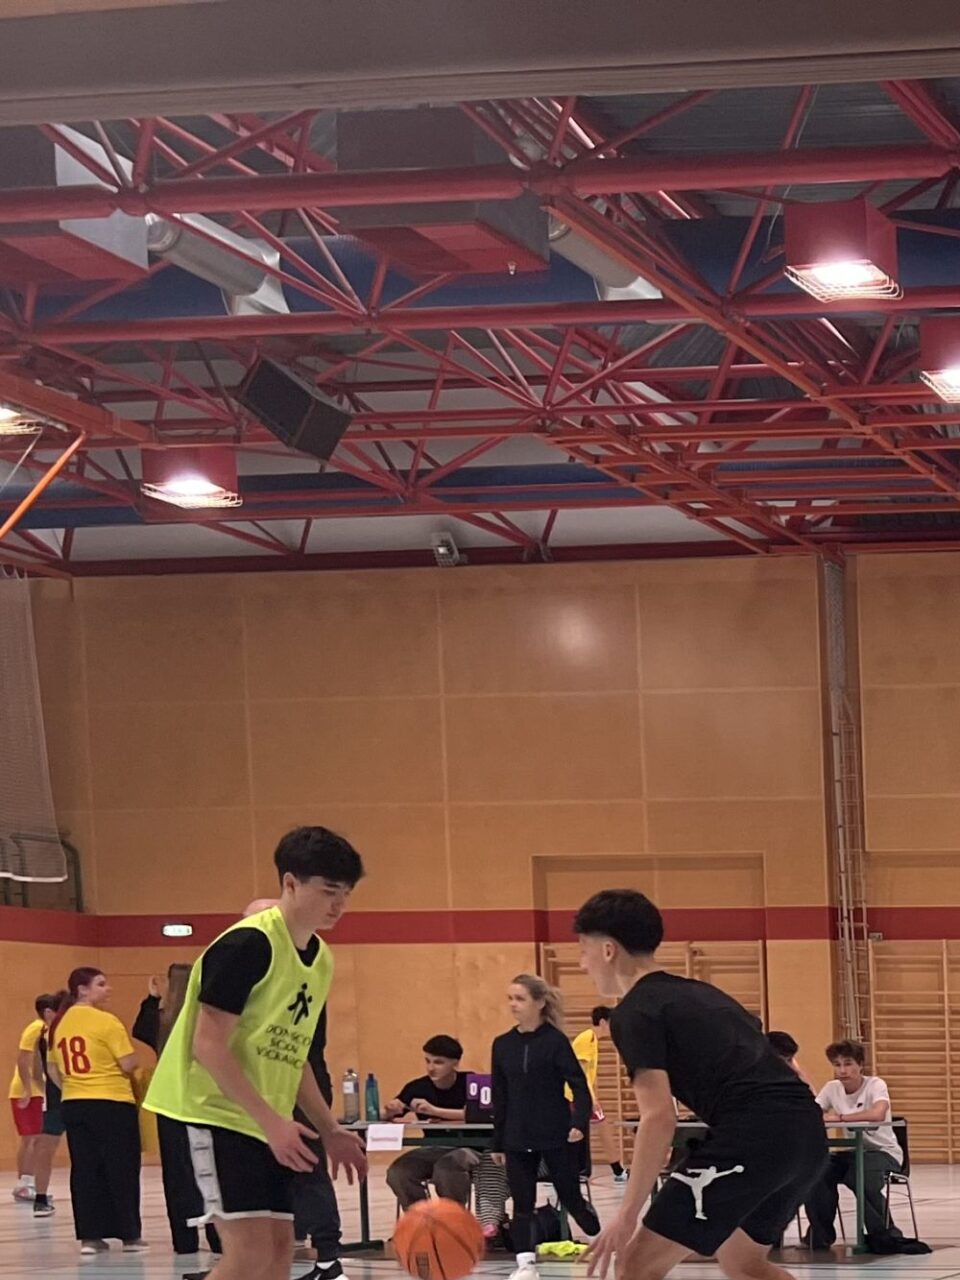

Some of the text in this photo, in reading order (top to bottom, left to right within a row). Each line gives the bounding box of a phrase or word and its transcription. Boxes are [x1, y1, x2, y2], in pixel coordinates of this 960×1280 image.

[57, 1036, 91, 1076] 18
[470, 1083, 492, 1105] 0 0
